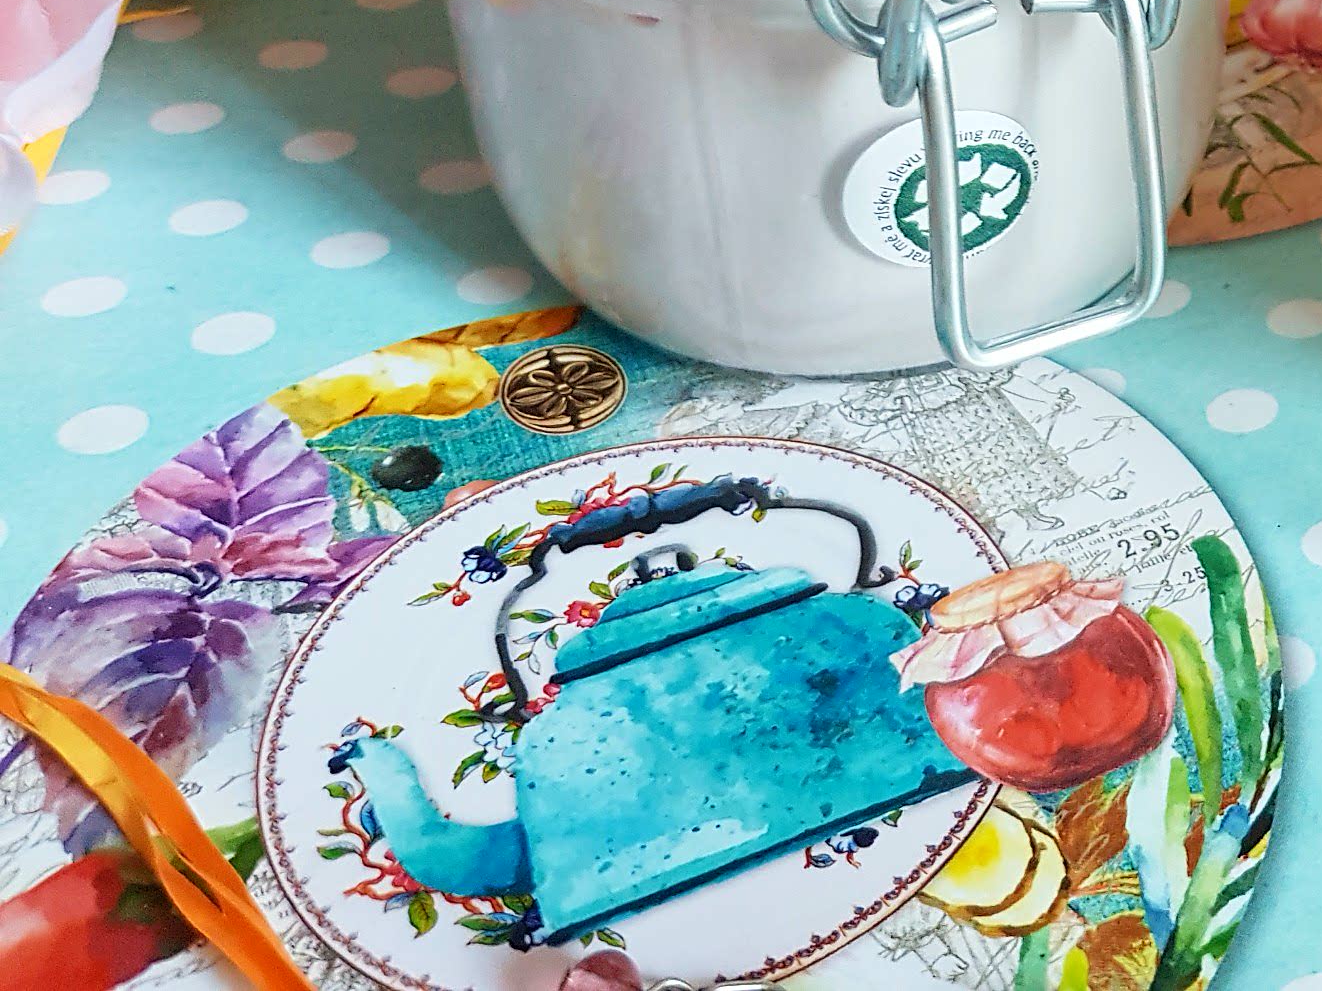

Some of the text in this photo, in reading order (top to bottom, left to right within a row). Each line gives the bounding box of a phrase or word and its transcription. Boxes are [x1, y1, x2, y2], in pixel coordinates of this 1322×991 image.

[987, 128, 1011, 141] me
[1011, 130, 1040, 159] back
[887, 151, 923, 185] slevu
[1116, 522, 1181, 559] 2.95
